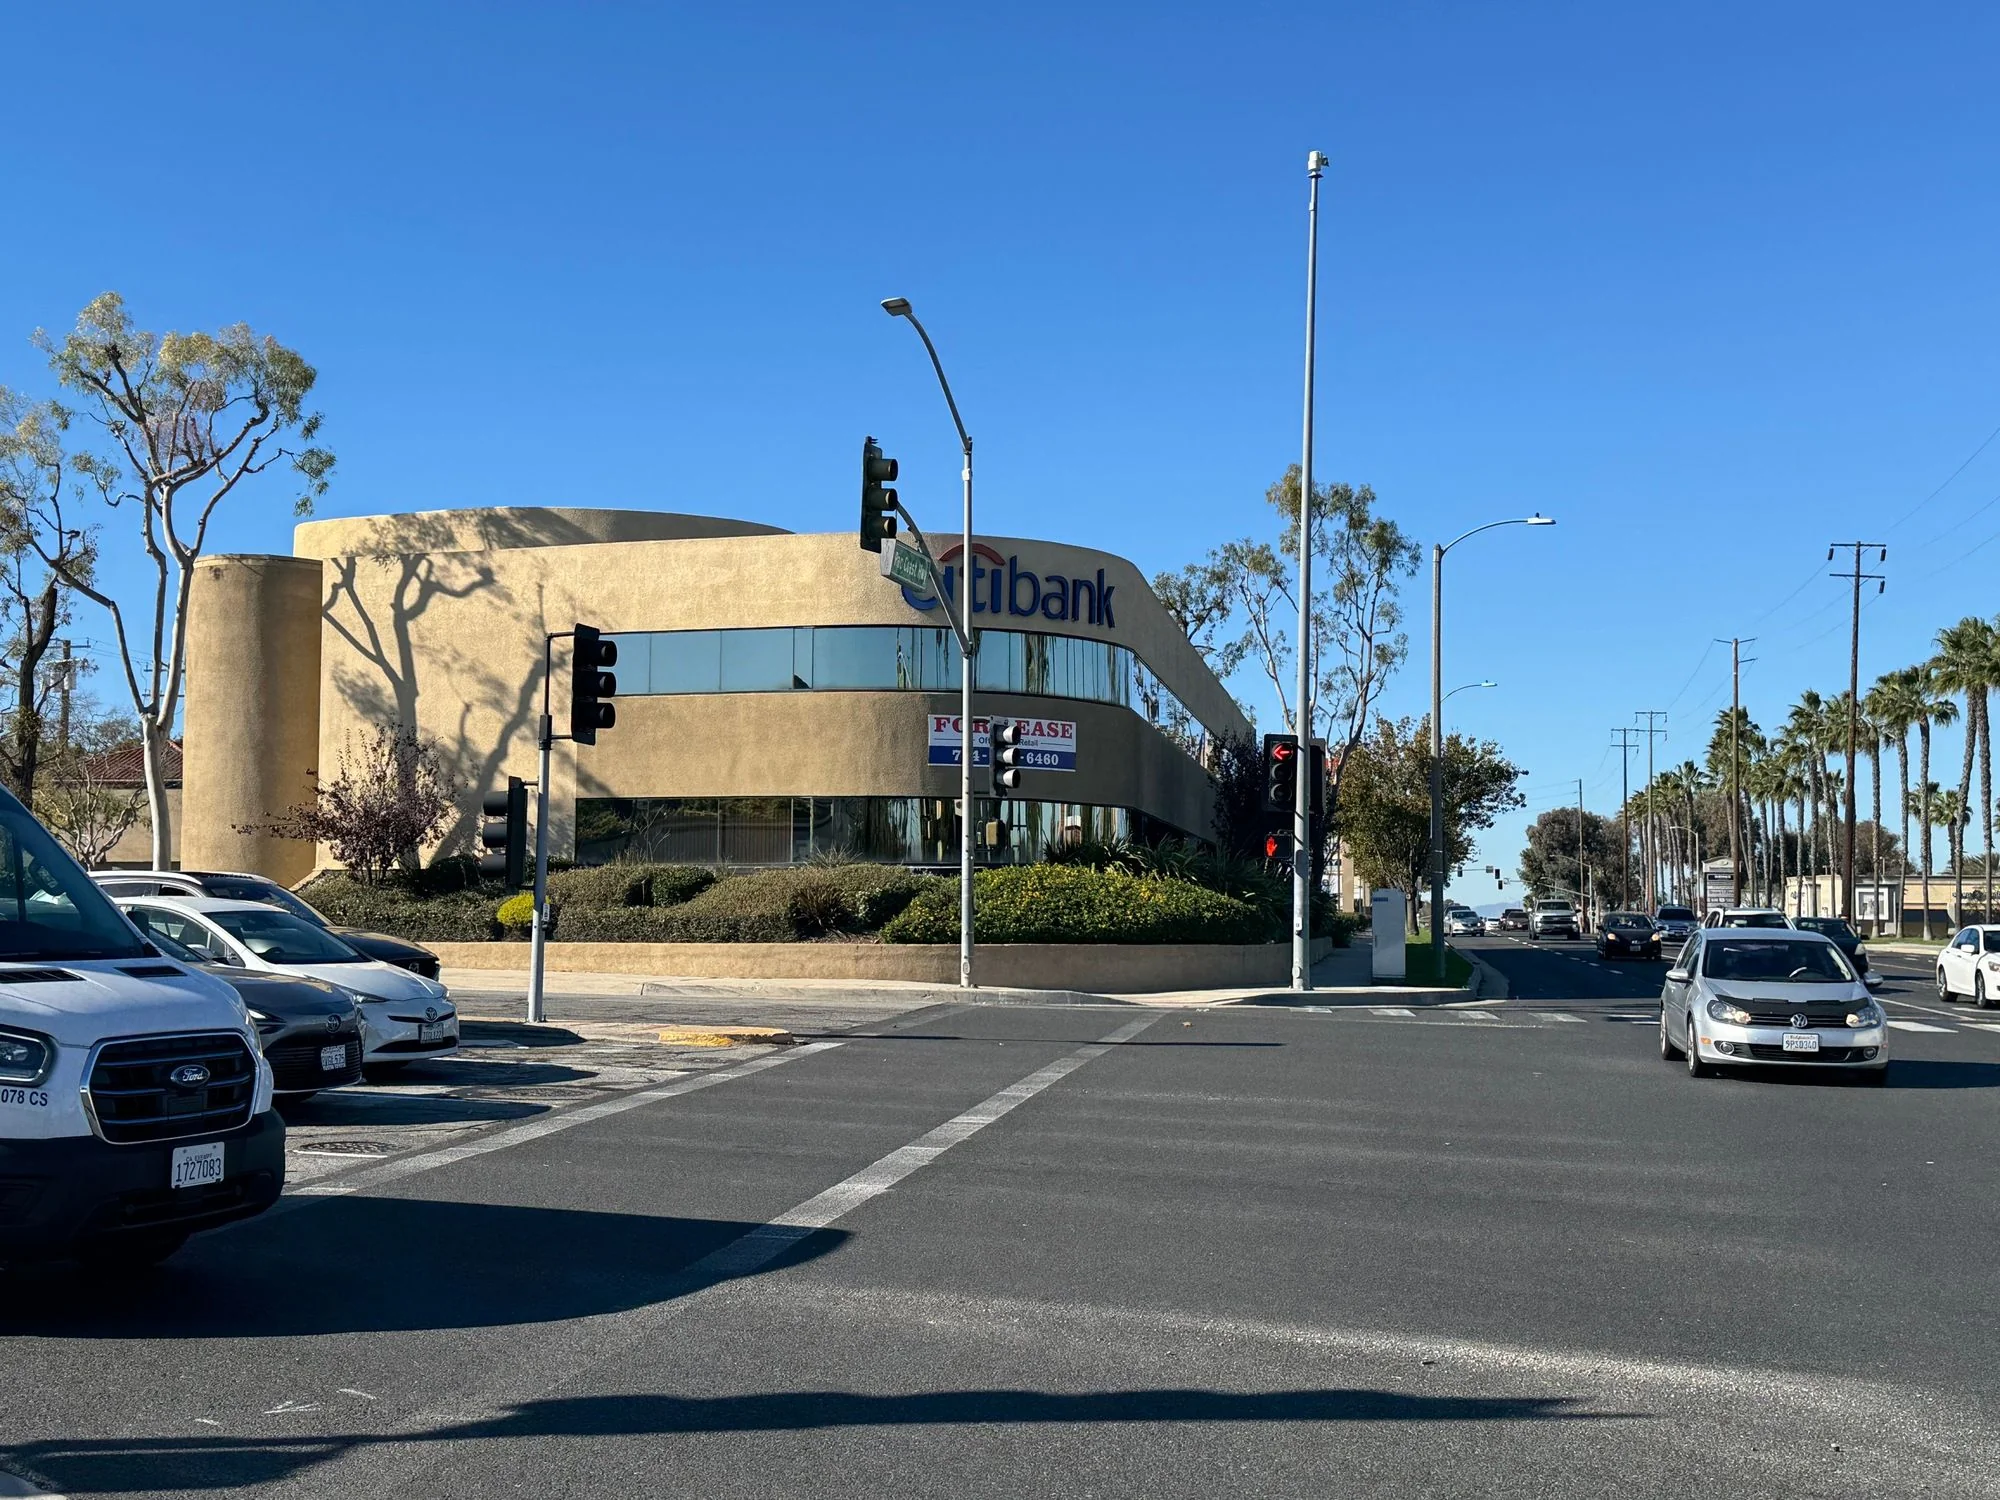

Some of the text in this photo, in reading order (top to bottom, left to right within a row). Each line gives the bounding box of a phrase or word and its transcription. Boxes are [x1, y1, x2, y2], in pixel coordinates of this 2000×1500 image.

[903, 557, 918, 577] Coast
[917, 564, 928, 586] Hwy
[1020, 738, 1039, 747] Retail
[182, 1068, 205, 1082] Ford
[29, 1091, 49, 1107] CS
[175, 1157, 222, 1183] 1727083
